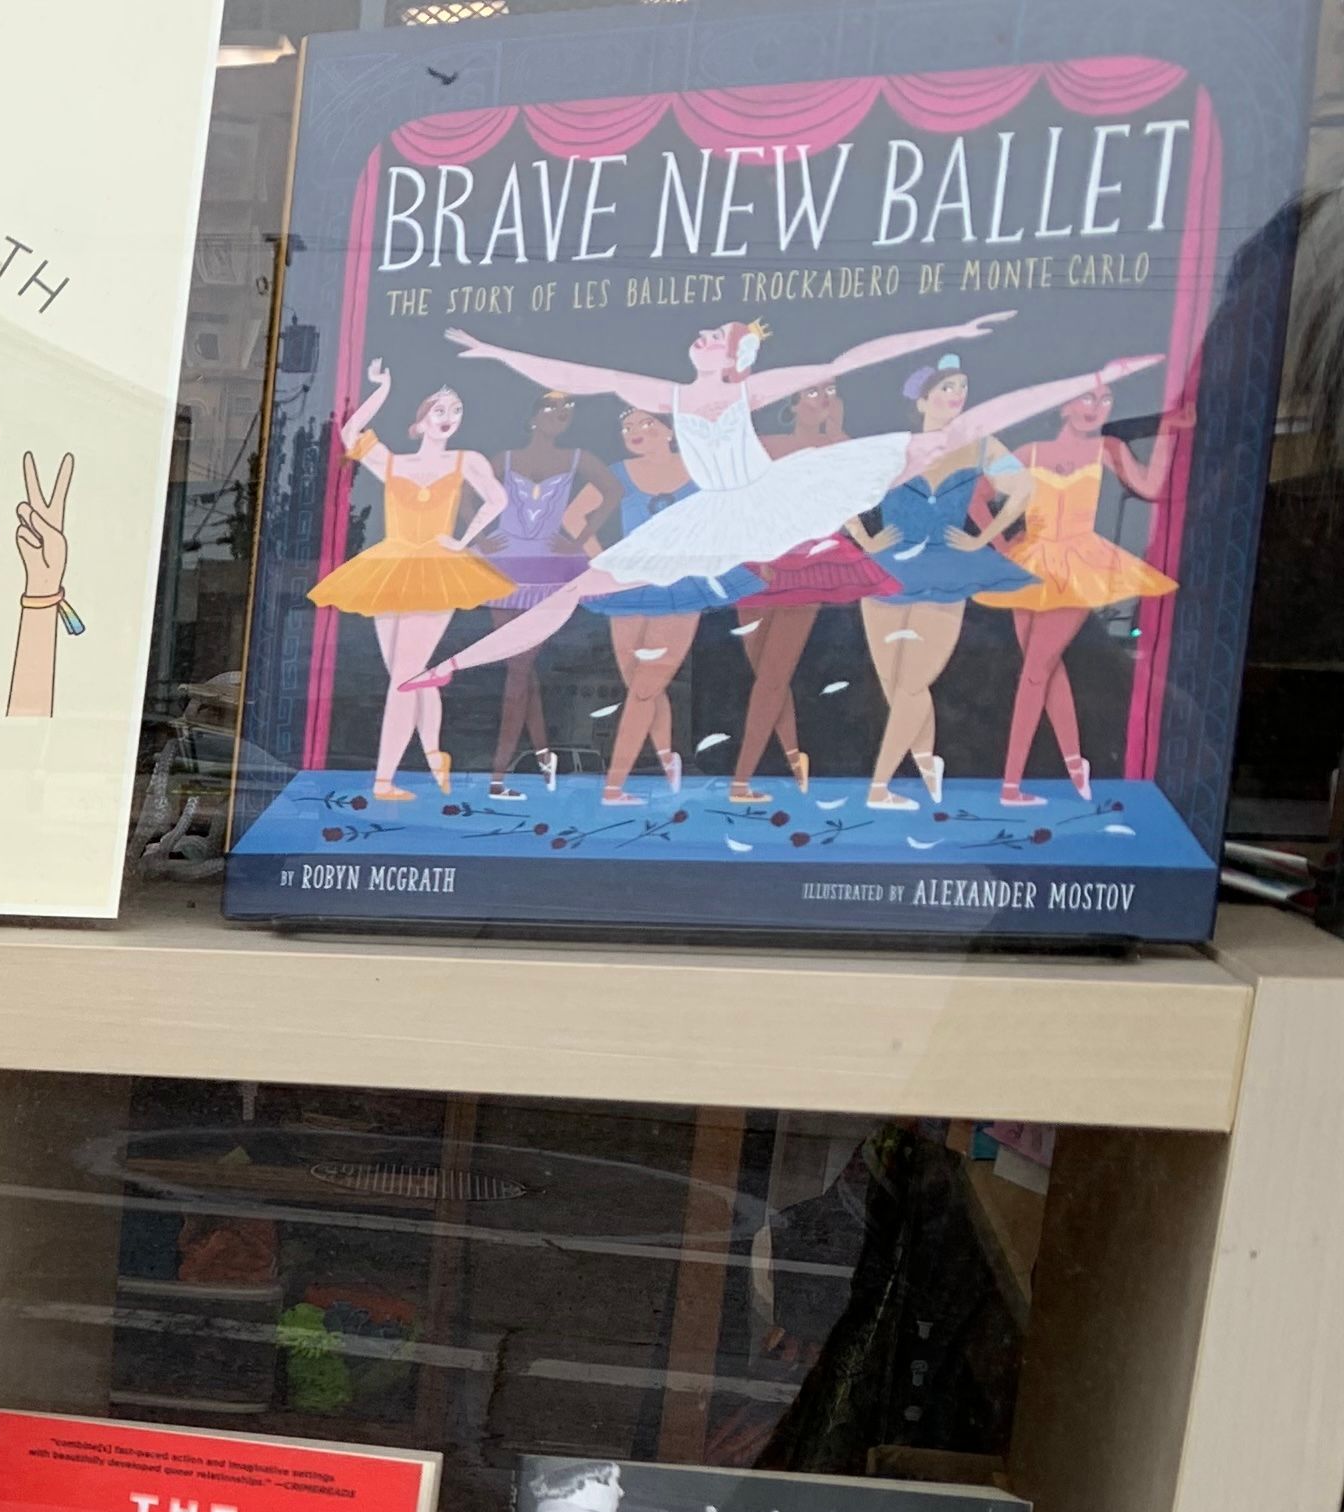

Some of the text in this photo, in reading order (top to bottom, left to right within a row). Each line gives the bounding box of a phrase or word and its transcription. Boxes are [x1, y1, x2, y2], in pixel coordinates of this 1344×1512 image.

[380, 119, 1190, 271] BRAVE NEW BALLET
[387, 252, 1150, 315] THE STORY OF LES BALLETS TROCKADERO DE MONTE CARLO
[301, 864, 455, 894] ROBYN MCGRATH
[912, 880, 1135, 913] ALEXANDER MOSTOV
